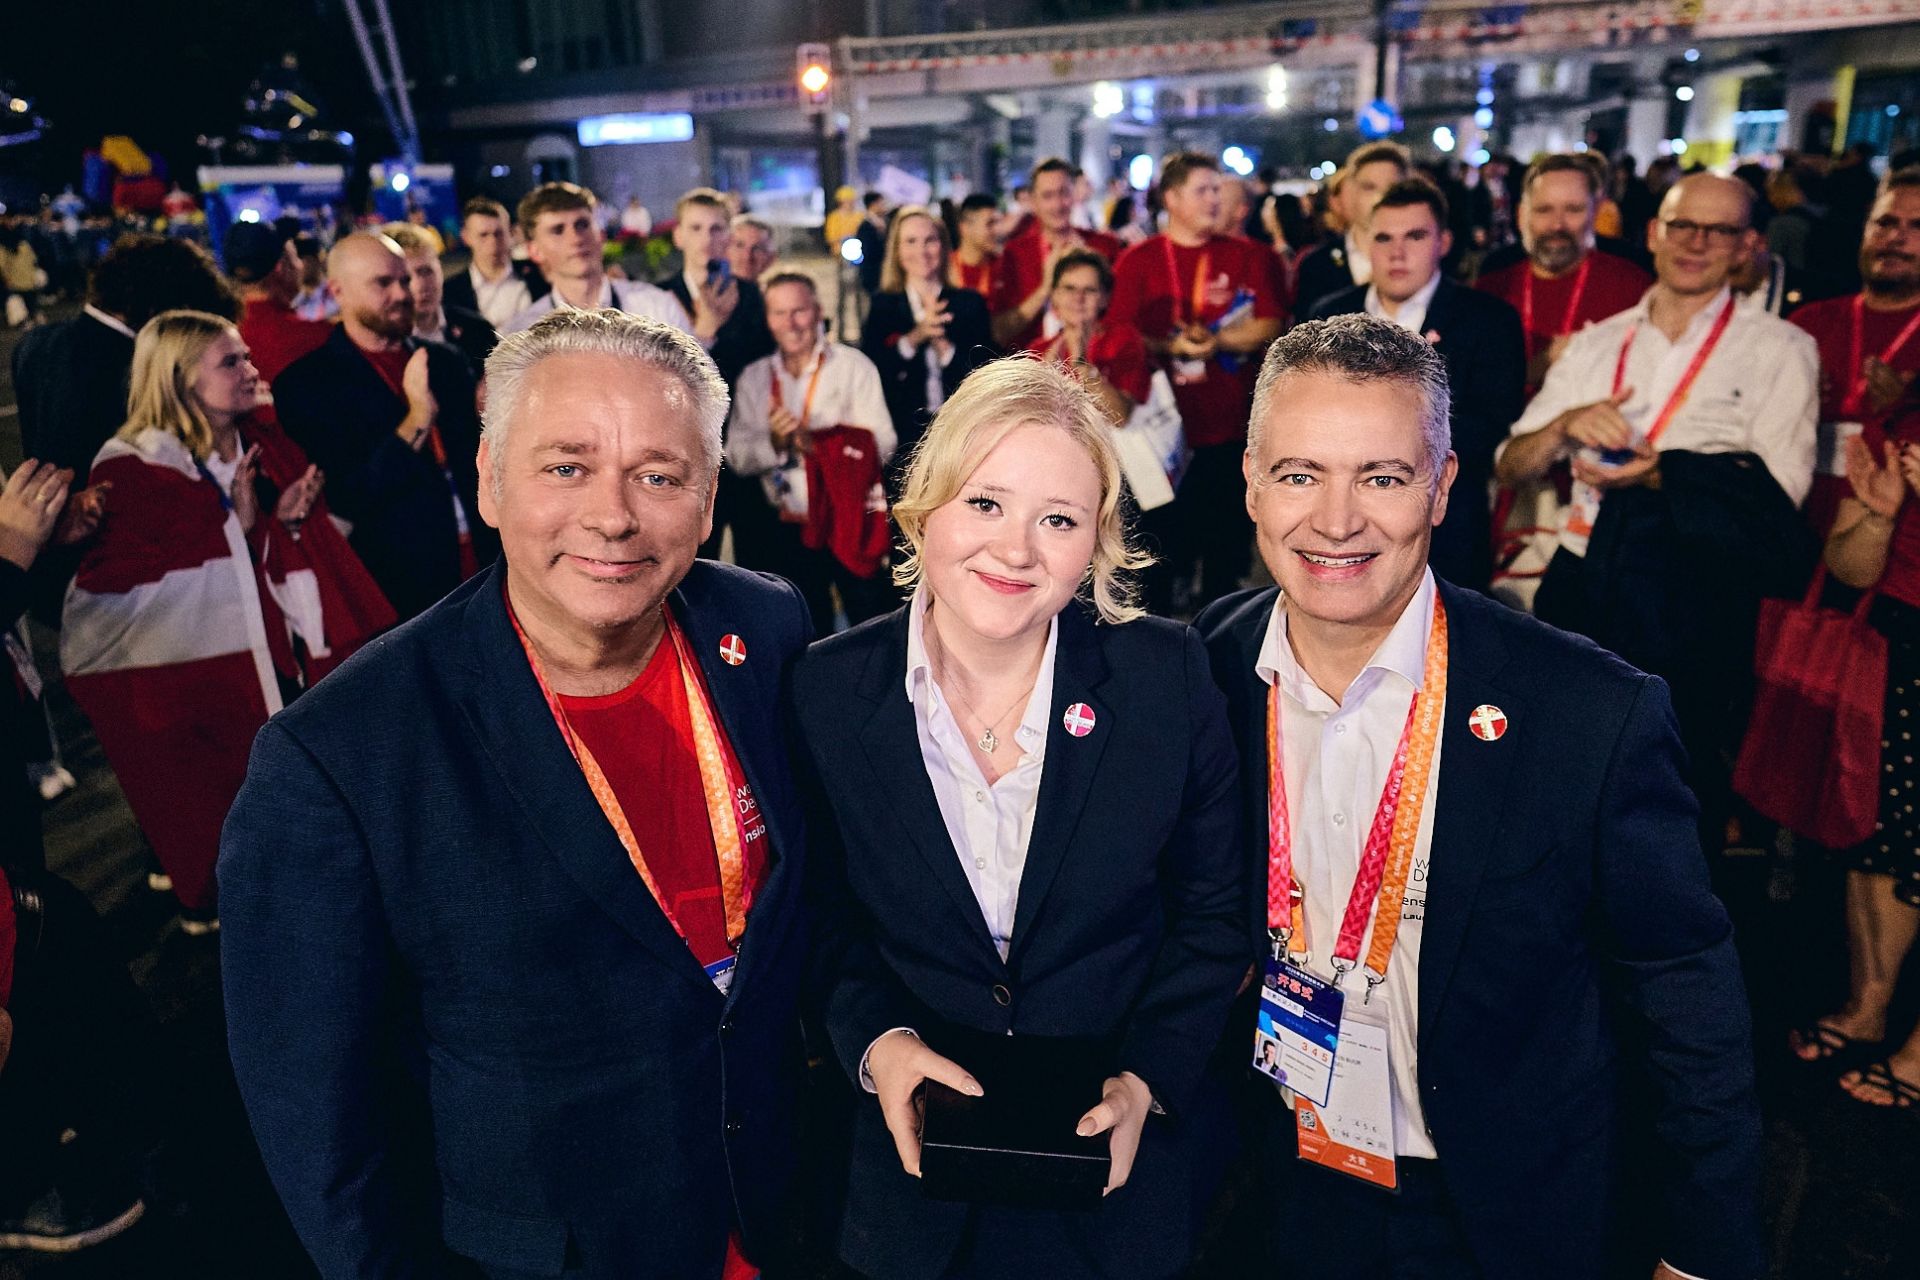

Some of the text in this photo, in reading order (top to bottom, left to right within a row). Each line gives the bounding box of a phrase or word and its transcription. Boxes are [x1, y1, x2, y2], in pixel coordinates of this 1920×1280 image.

[1414, 869, 1428, 881] D
[1402, 897, 1426, 907] ens
[1301, 1042, 1308, 1051] 3
[1312, 1048, 1318, 1057] 4
[1322, 1053, 1328, 1062] 5
